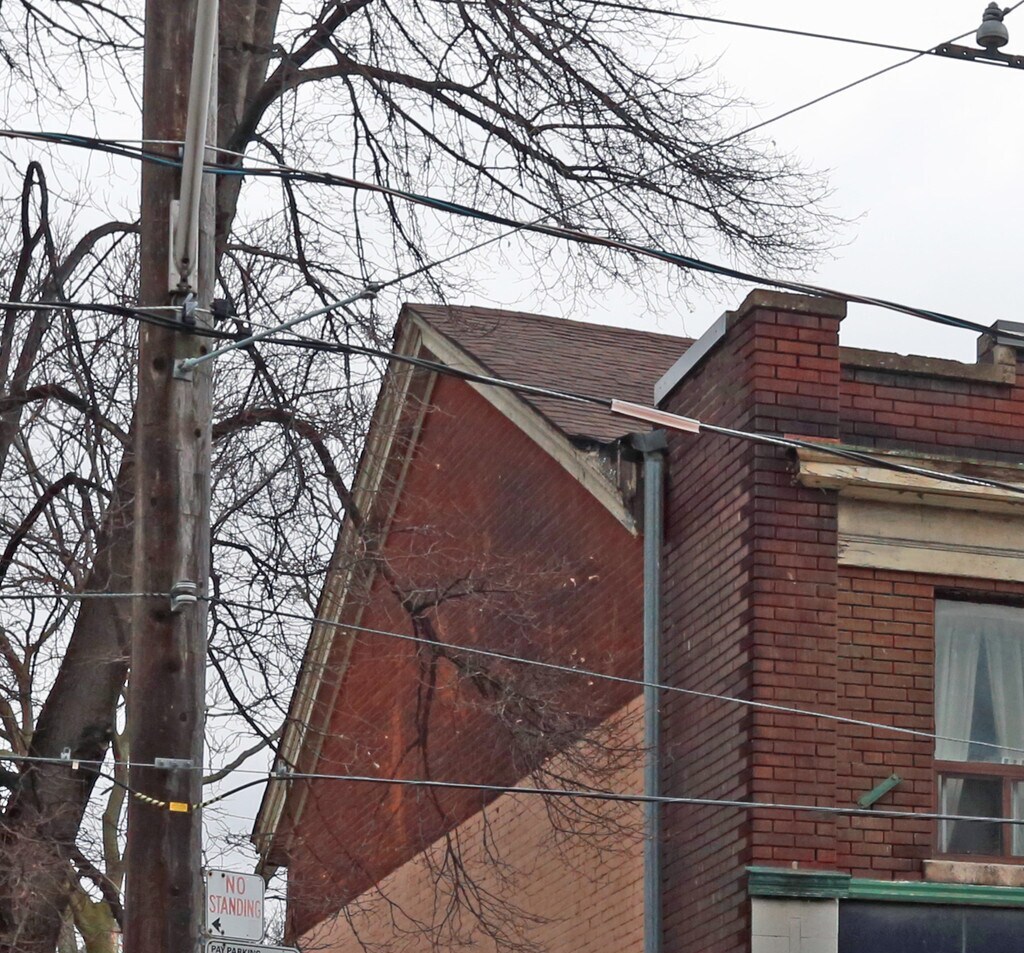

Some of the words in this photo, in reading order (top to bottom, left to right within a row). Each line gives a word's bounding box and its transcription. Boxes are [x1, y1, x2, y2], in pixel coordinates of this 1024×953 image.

[226, 875, 246, 895] NO
[209, 894, 262, 918] STANDING
[211, 945, 225, 953] PAY
